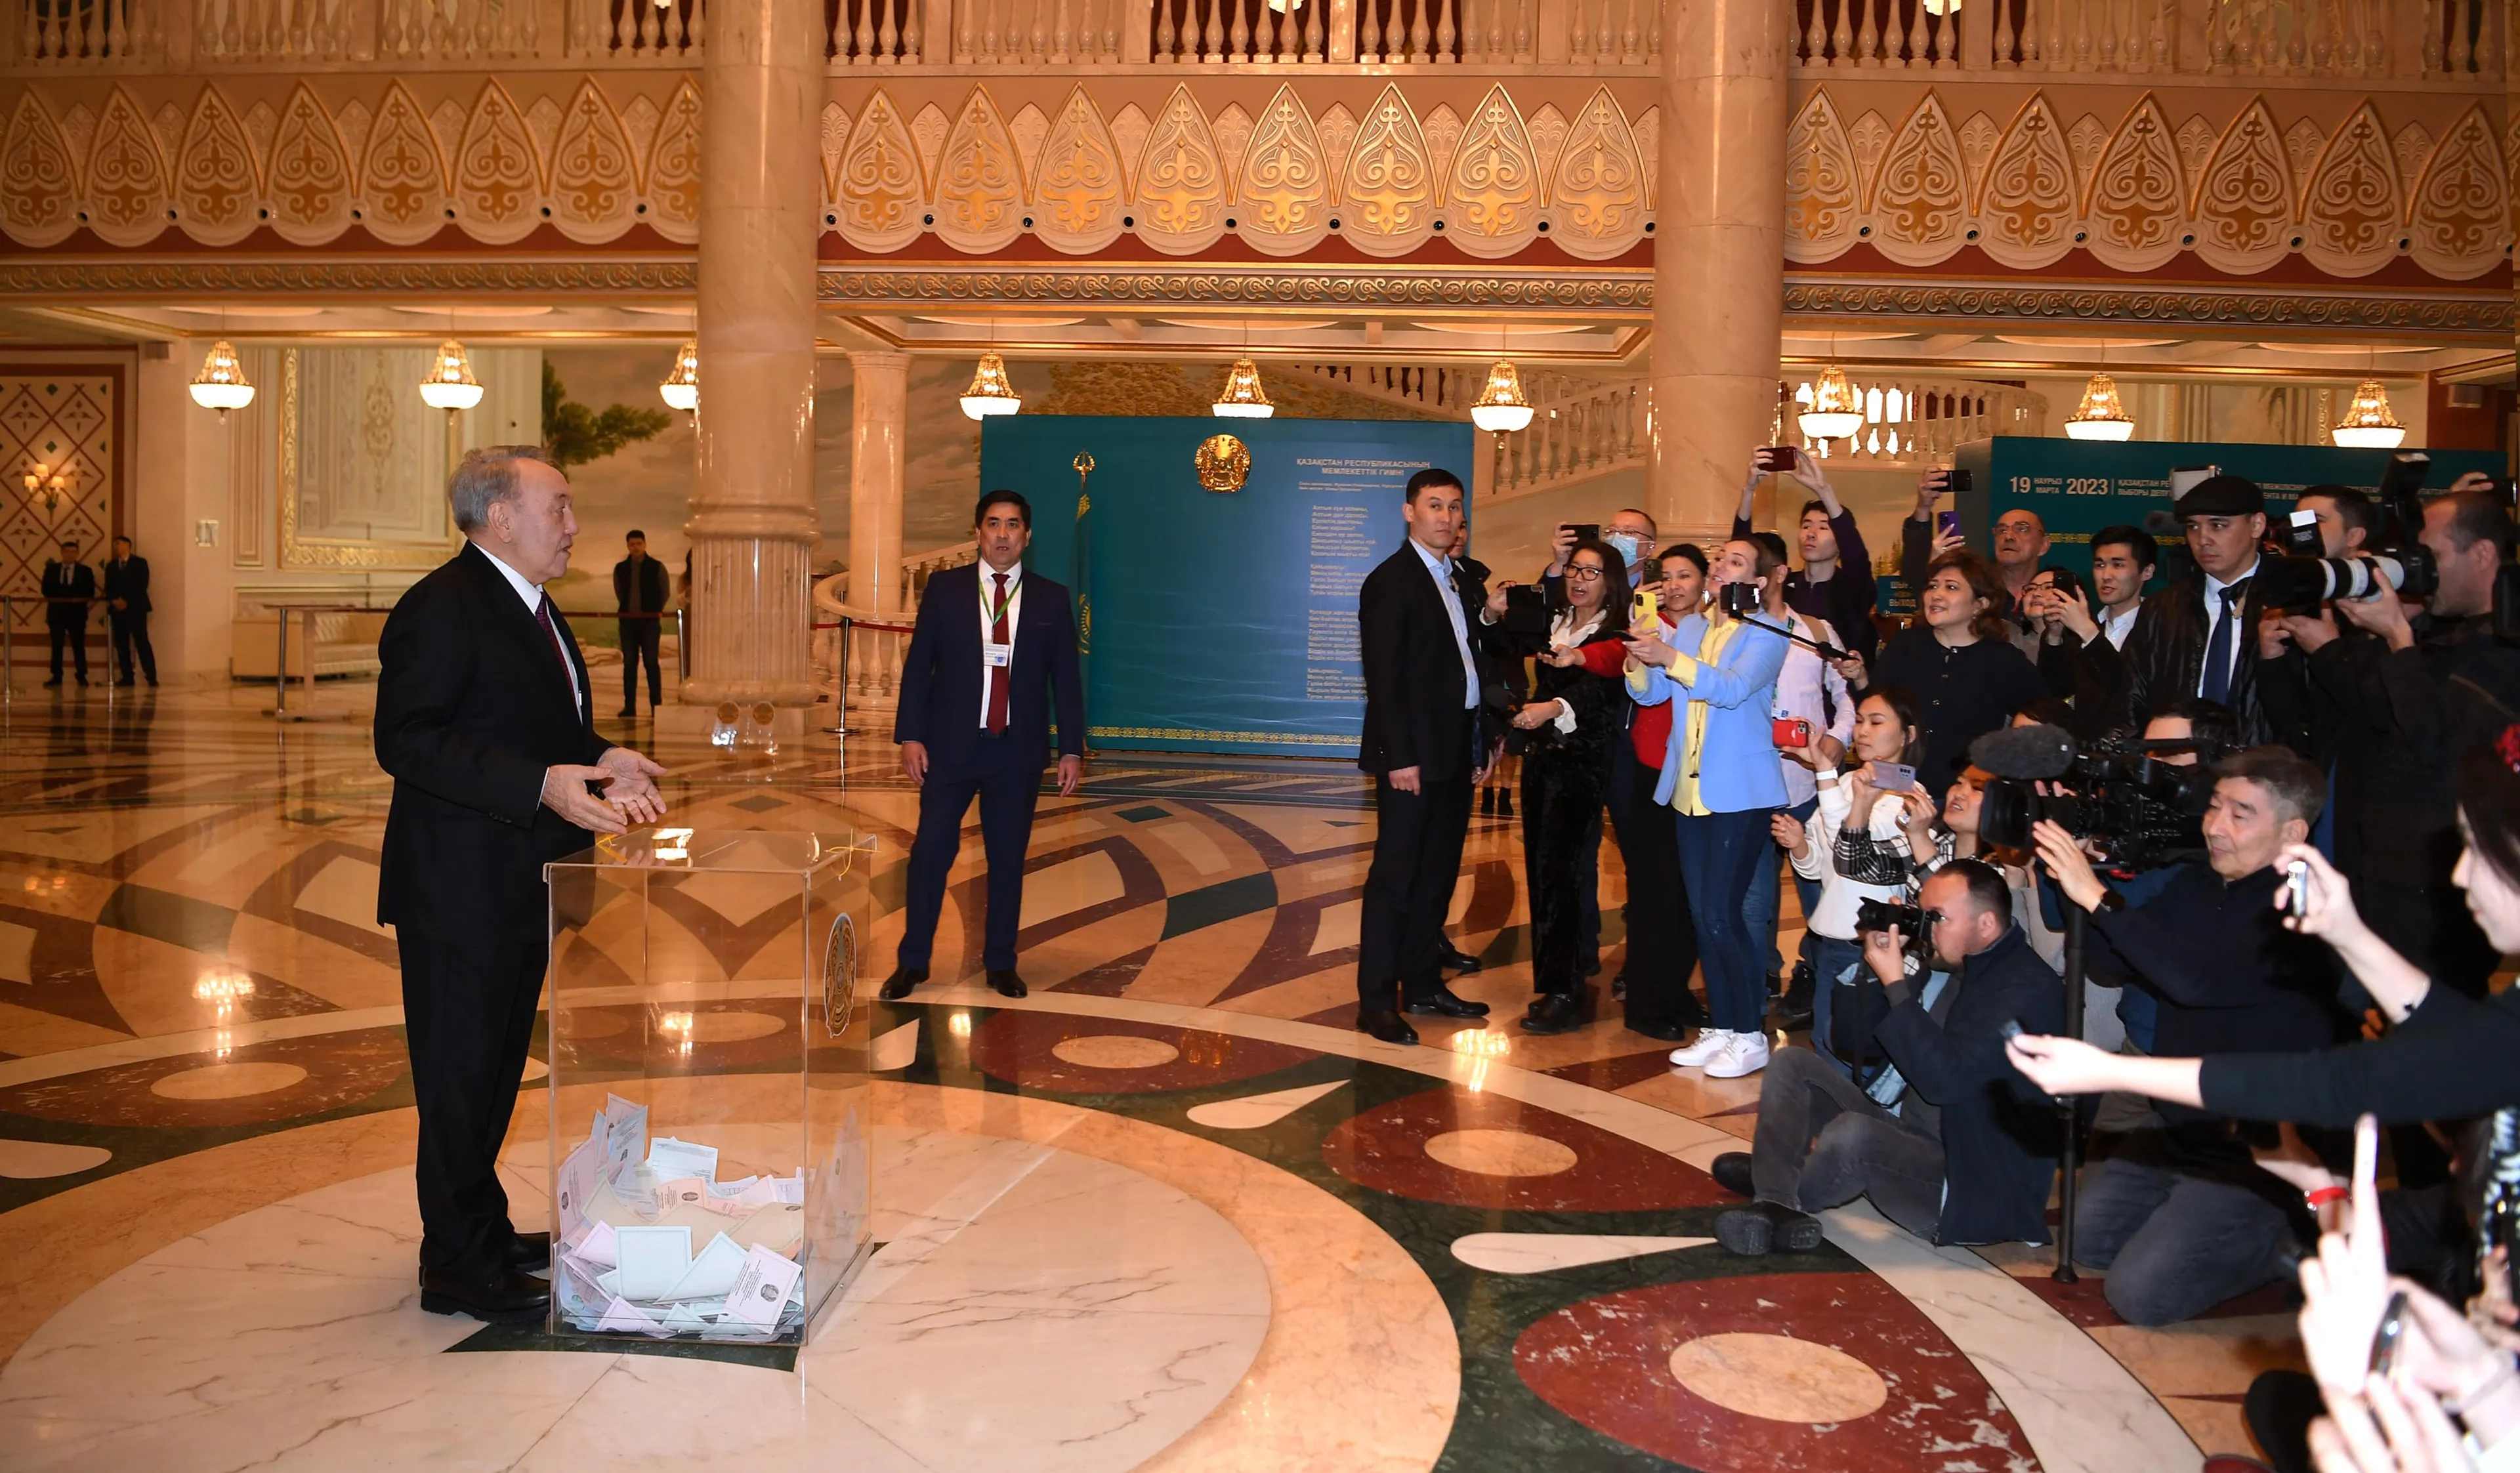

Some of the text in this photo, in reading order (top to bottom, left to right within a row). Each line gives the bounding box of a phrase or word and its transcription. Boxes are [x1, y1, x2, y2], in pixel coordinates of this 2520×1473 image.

[1345, 460, 1430, 468] РЕСПУБЛИКАСЫНЫҢ
[2010, 476, 2031, 493] 19
[2066, 478, 2109, 495] 2023
[2118, 479, 2159, 488] ҚАЗАҚСТАН
[1889, 598, 1916, 608] ВЫХОД
